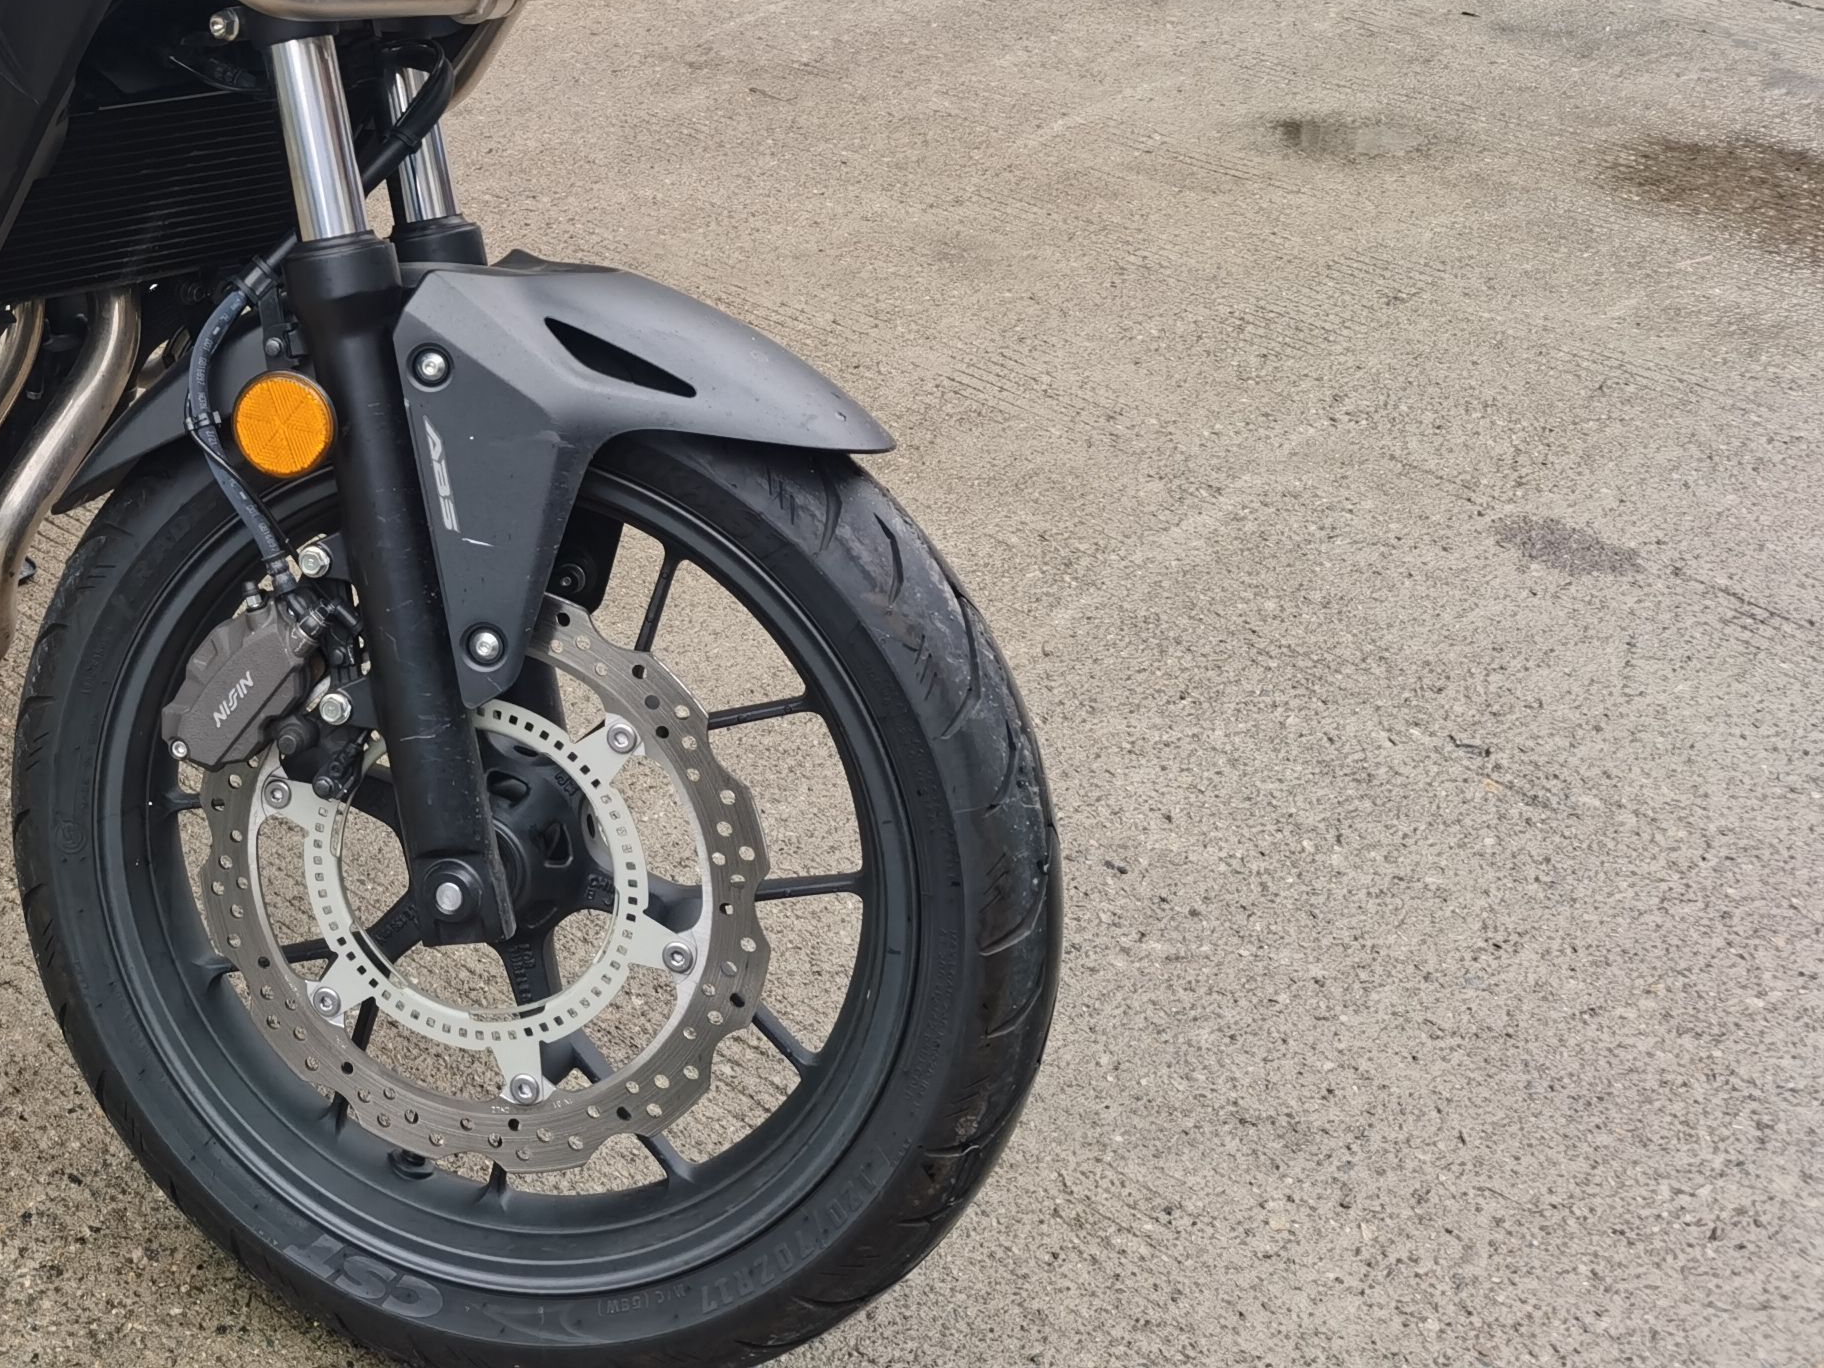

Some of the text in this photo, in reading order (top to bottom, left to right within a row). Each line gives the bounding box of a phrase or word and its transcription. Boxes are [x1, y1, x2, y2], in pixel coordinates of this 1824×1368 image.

[422, 416, 461, 533] ABS
[212, 671, 255, 729] NISSIN
[280, 1232, 444, 1318] CST
